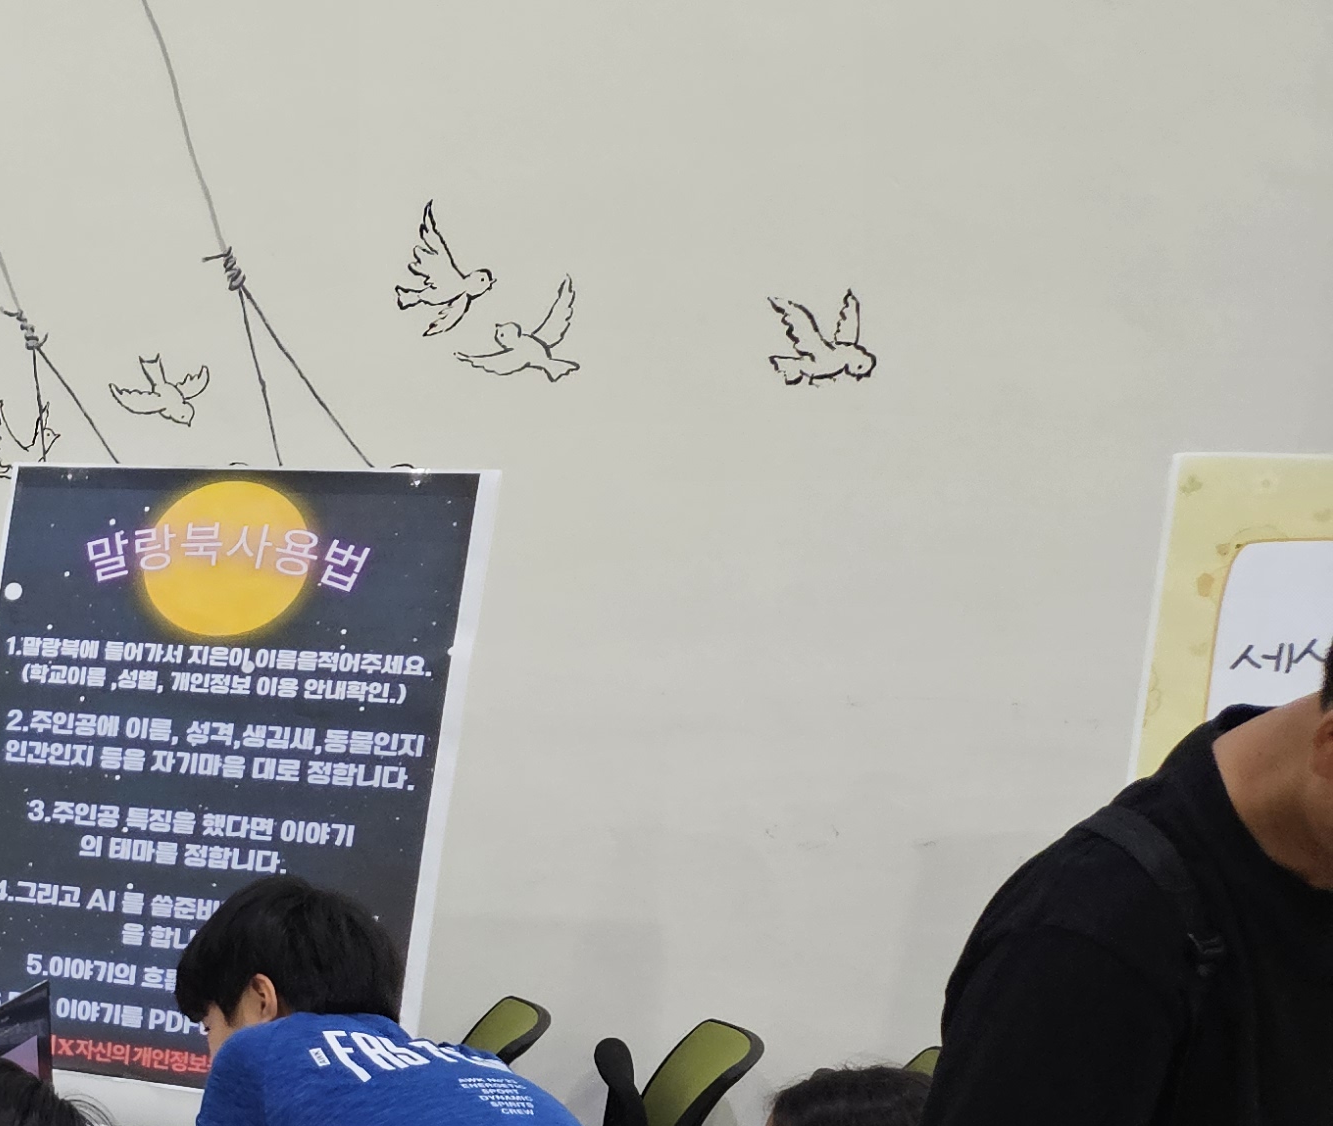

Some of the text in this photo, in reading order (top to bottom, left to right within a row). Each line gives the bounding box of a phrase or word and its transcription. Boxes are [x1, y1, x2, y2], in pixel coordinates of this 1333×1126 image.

[86, 521, 370, 592] 말랑북사용법
[6, 635, 100, 659] 1.말랑북에
[104, 641, 184, 664] 들어가서
[22, 663, 107, 687] (학교이름
[171, 671, 251, 696] 개인정보
[256, 676, 299, 698] 이용
[303, 679, 407, 705] 안내확인.)
[5, 709, 120, 738] 2.주인공에
[125, 717, 179, 746] 이름,
[5, 740, 415, 791] 인간인지 등을 자기마음 대로 정합니다.
[27, 800, 356, 847] 3.주인공 특징을 했다면 이야기
[79, 834, 103, 857] 의
[184, 843, 287, 874] 정합니다.
[86, 889, 116, 912] AI
[122, 891, 144, 915] 를
[150, 894, 221, 921] 쓸준비
[122, 922, 197, 949] 을 합니
[26, 953, 137, 986] 5.이야기의
[56, 997, 144, 1029] 이야기를
[133, 1047, 212, 1073] 개인정보
[501, 1108, 534, 1116] CREW
